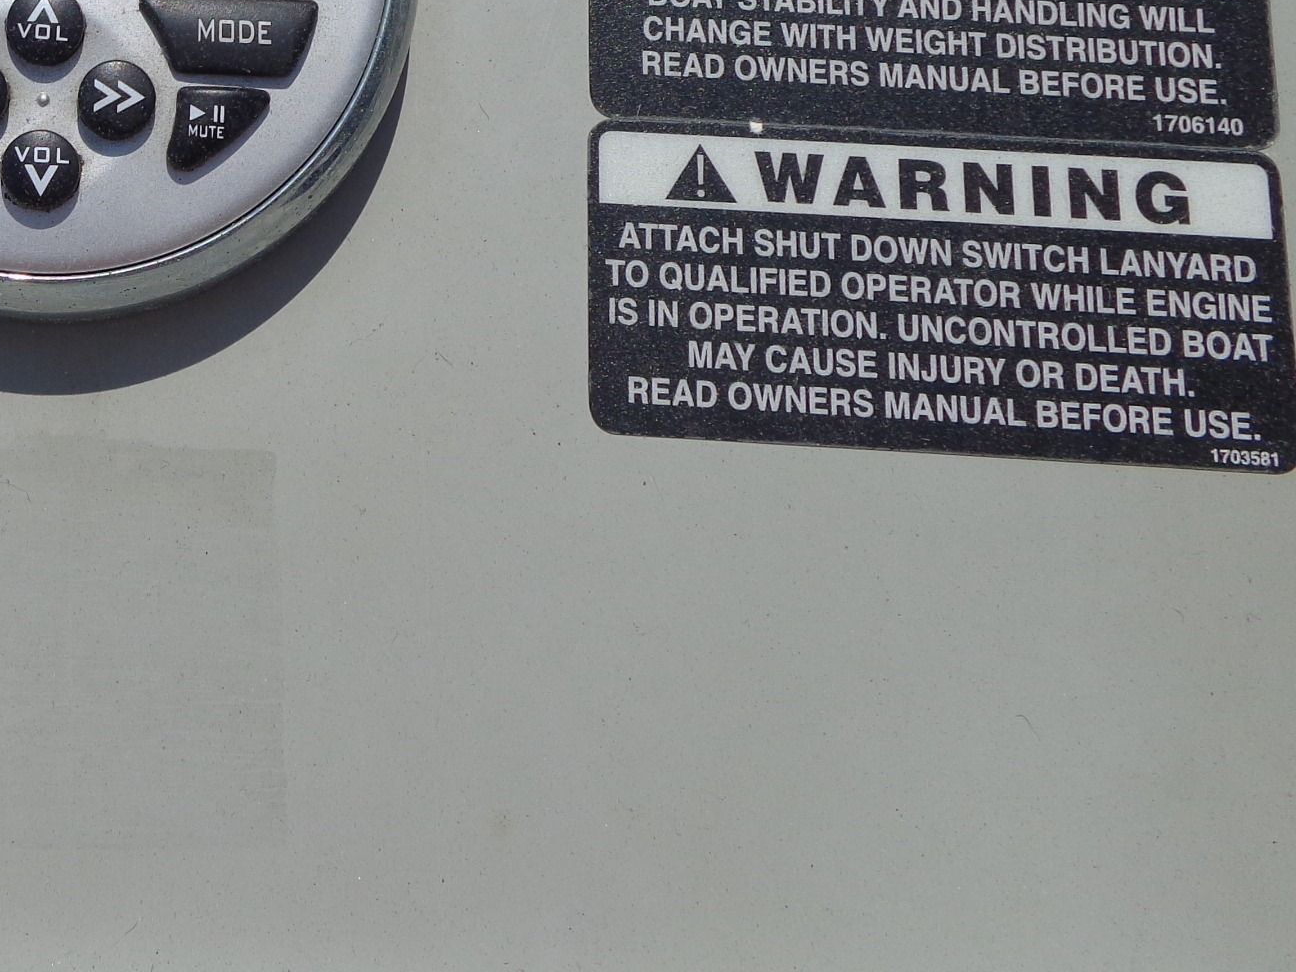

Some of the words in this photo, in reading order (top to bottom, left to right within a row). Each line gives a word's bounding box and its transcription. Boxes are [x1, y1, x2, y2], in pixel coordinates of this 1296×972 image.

[18, 23, 68, 42] VOL
[197, 18, 272, 45] MODE
[643, 15, 771, 46] CHANGE
[781, 23, 857, 50] WITH
[865, 26, 986, 57] WEIGHT
[996, 33, 1222, 69] DISTRIBUTION.
[1139, 5, 1215, 34] WILL
[642, 50, 725, 79] READ
[734, 54, 870, 86] OWNERS
[880, 63, 1011, 94] MANUAL
[1019, 70, 1145, 101] BEFORE
[1155, 77, 1227, 105] USE.
[188, 124, 225, 139] MUTE
[1152, 114, 1244, 136] 1706140
[14, 146, 70, 164] VOL
[754, 150, 1191, 225] WARNING
[618, 222, 744, 254] ATTACH
[754, 228, 841, 260] SHUT
[851, 234, 952, 266] DOWN
[962, 240, 1090, 274] SWITCH
[1100, 248, 1256, 284] LANYARD
[605, 259, 649, 288] TO
[659, 261, 832, 298] QUALIFIED
[841, 271, 1021, 309] OPERATOR
[1031, 282, 1137, 315] WHILE
[1147, 289, 1273, 323] ENGINE
[608, 297, 638, 326] IS
[648, 300, 679, 328] IN
[689, 301, 887, 340] OPERATION.
[897, 314, 1172, 356] UNCONTROLLED
[1182, 330, 1273, 362] BOAT
[688, 340, 755, 371] MAY
[765, 344, 878, 379] CAUSE
[888, 351, 1005, 385] INJURY
[1016, 359, 1064, 389] OR
[1075, 362, 1195, 397] DEATH.
[628, 376, 718, 408] READ
[728, 381, 874, 418] OWNERS
[884, 391, 1026, 427] MANUAL
[1036, 400, 1174, 436] BEFORE
[1184, 409, 1262, 441] USE.
[1210, 448, 1280, 467] 1703581
